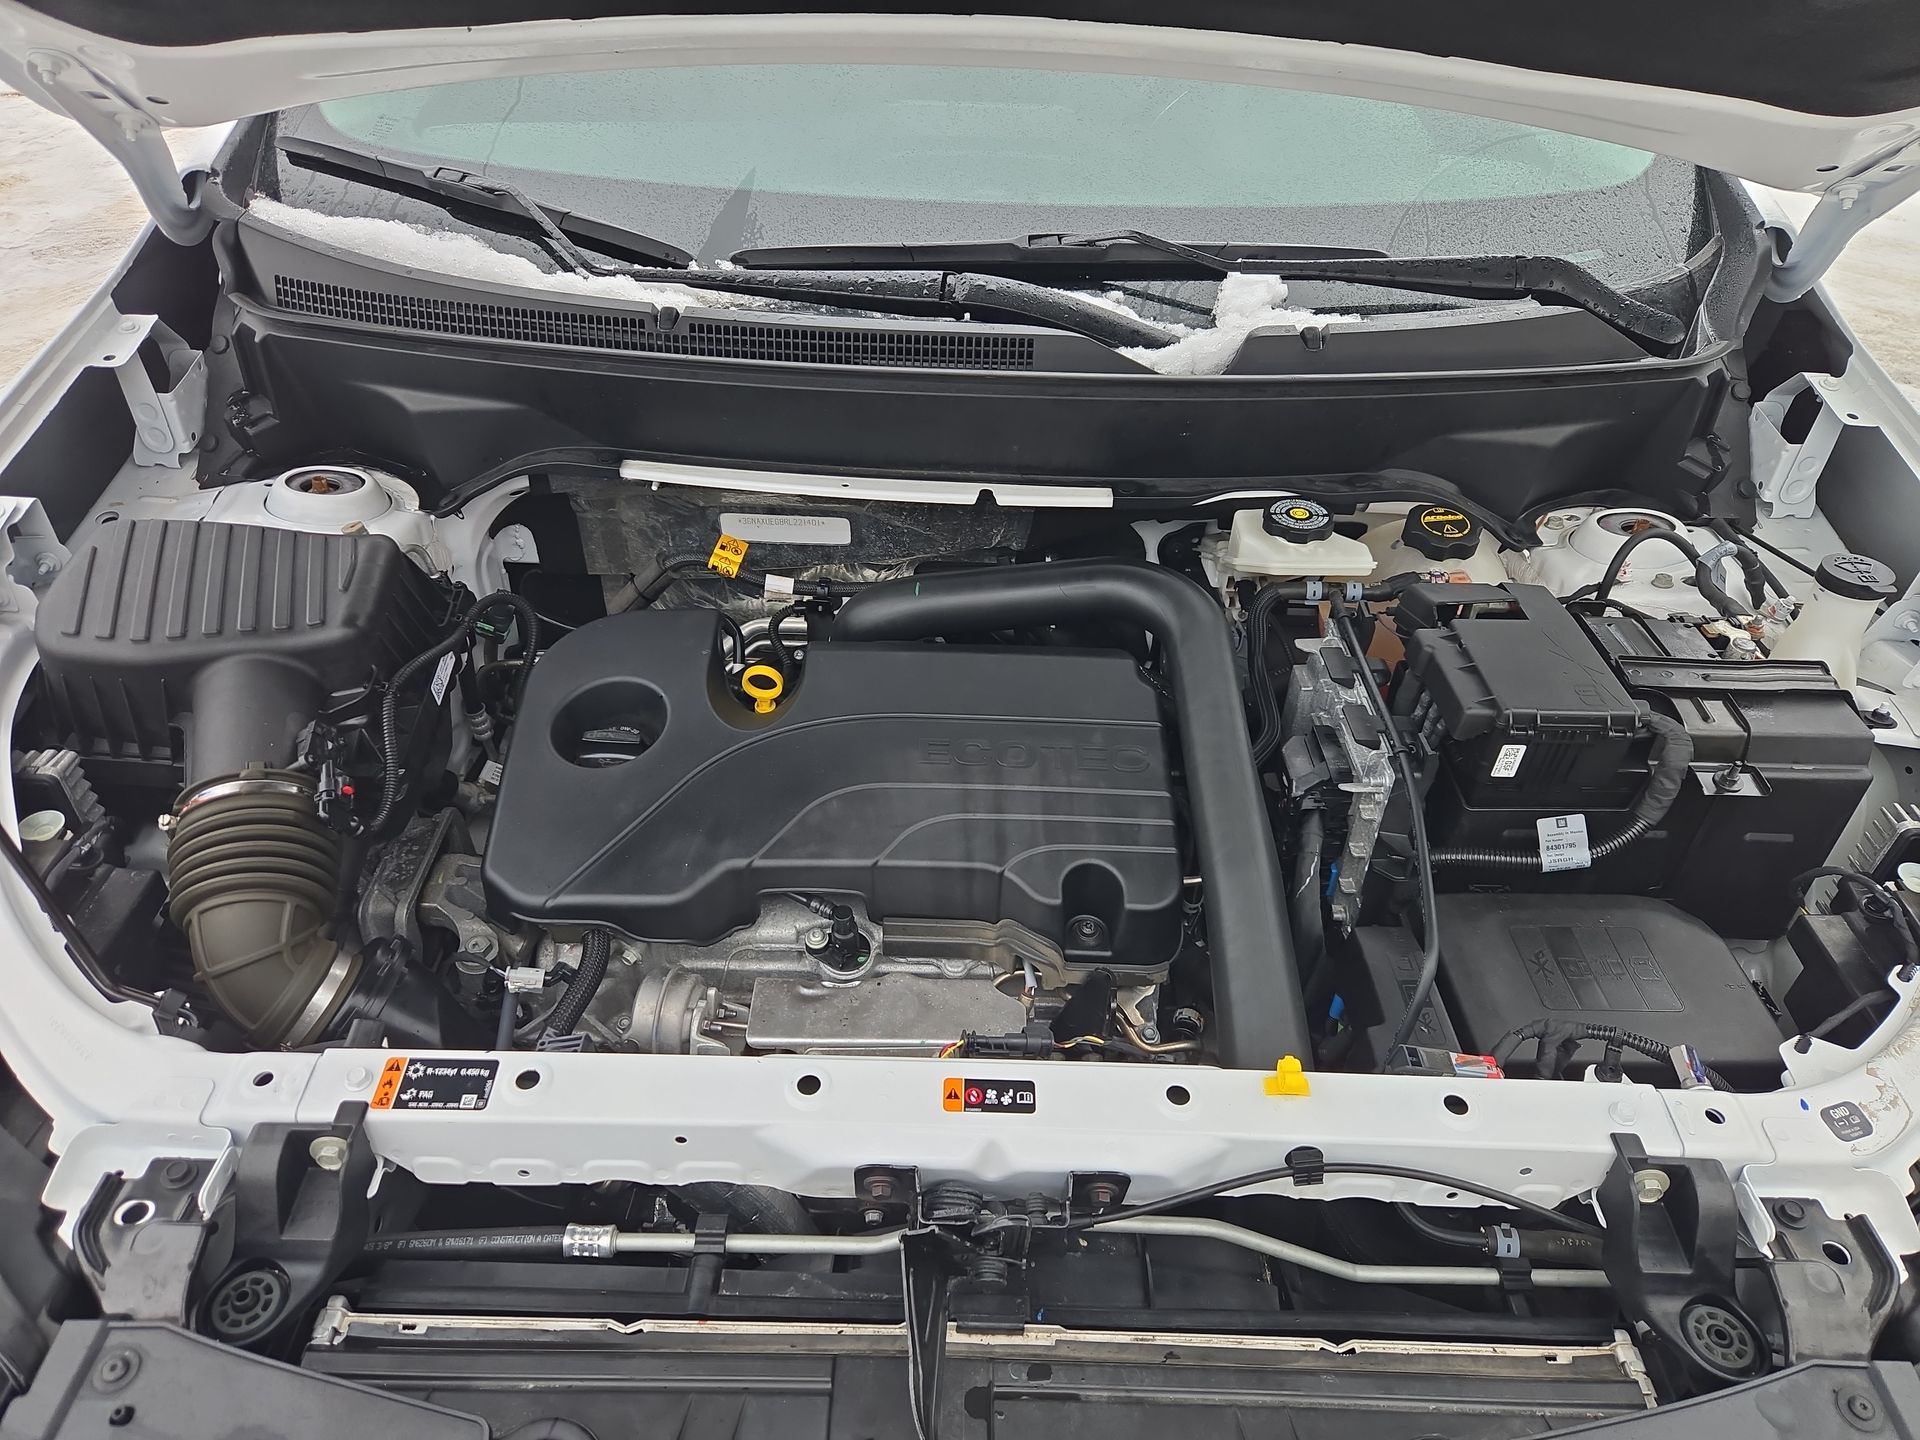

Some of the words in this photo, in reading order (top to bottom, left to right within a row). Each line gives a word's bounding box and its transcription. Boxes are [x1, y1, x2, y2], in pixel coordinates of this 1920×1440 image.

[916, 739, 1150, 773] ECOTEC
[1546, 842, 1577, 851] 84301795
[418, 1090, 434, 1099] PAG
[1830, 1106, 1850, 1119] GND
[491, 1234, 536, 1245] CONSTRUCTION
